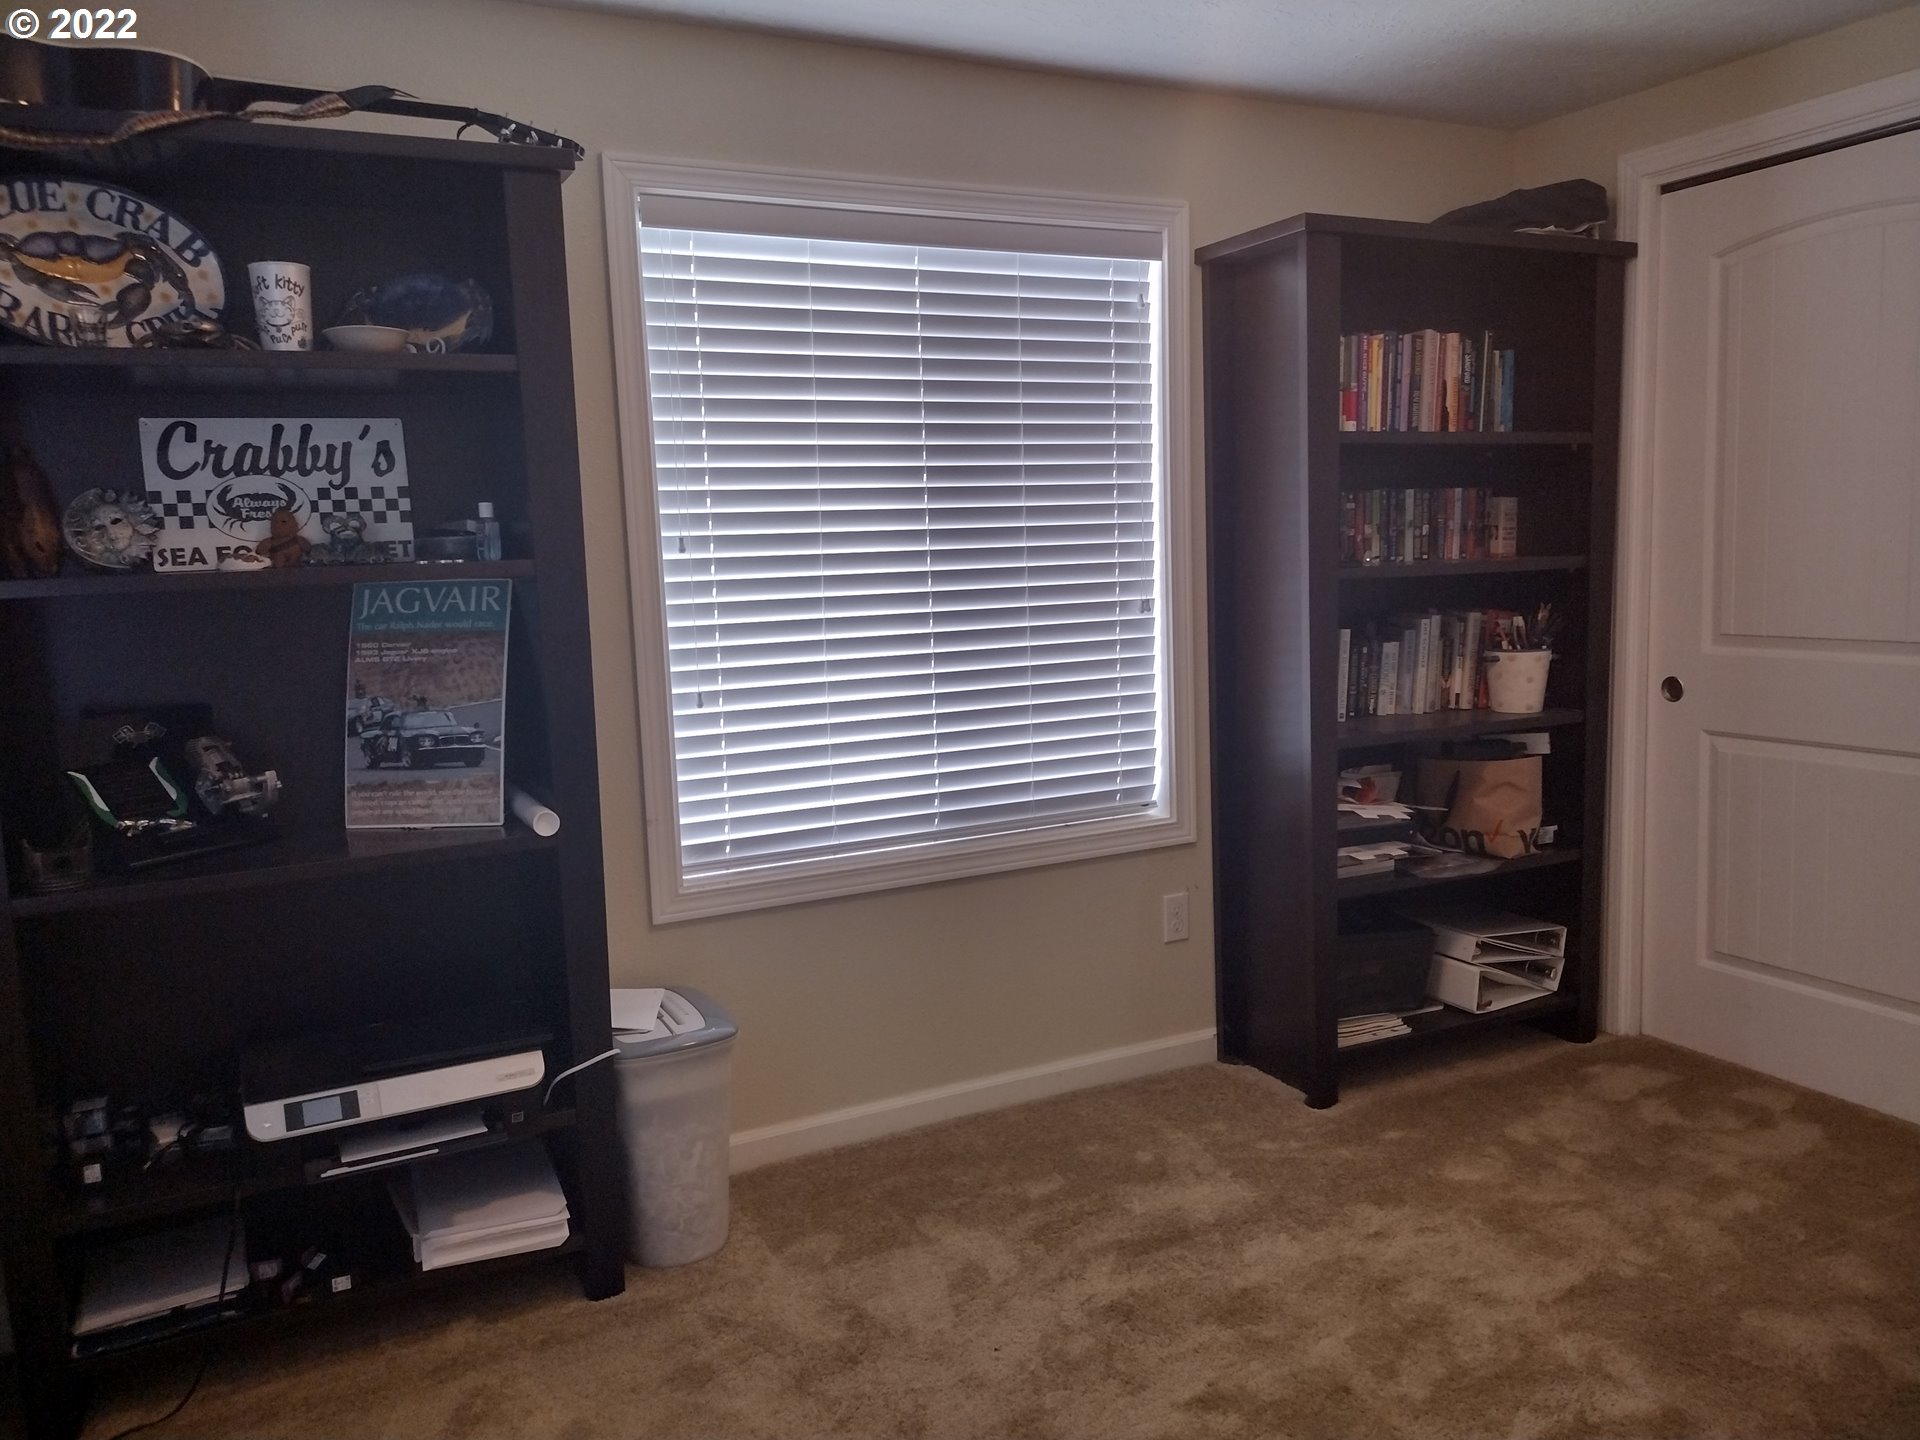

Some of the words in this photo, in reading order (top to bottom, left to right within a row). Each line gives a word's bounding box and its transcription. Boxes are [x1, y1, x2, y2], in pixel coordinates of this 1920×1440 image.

[0, 180, 67, 218] UE
[86, 188, 210, 268] CRAB
[275, 273, 305, 297] kitty
[157, 420, 396, 490] Crabby's
[232, 497, 287, 514] Always
[240, 508, 273, 519] Fres
[158, 547, 208, 567] SEA
[359, 586, 501, 620] JAGVAIR
